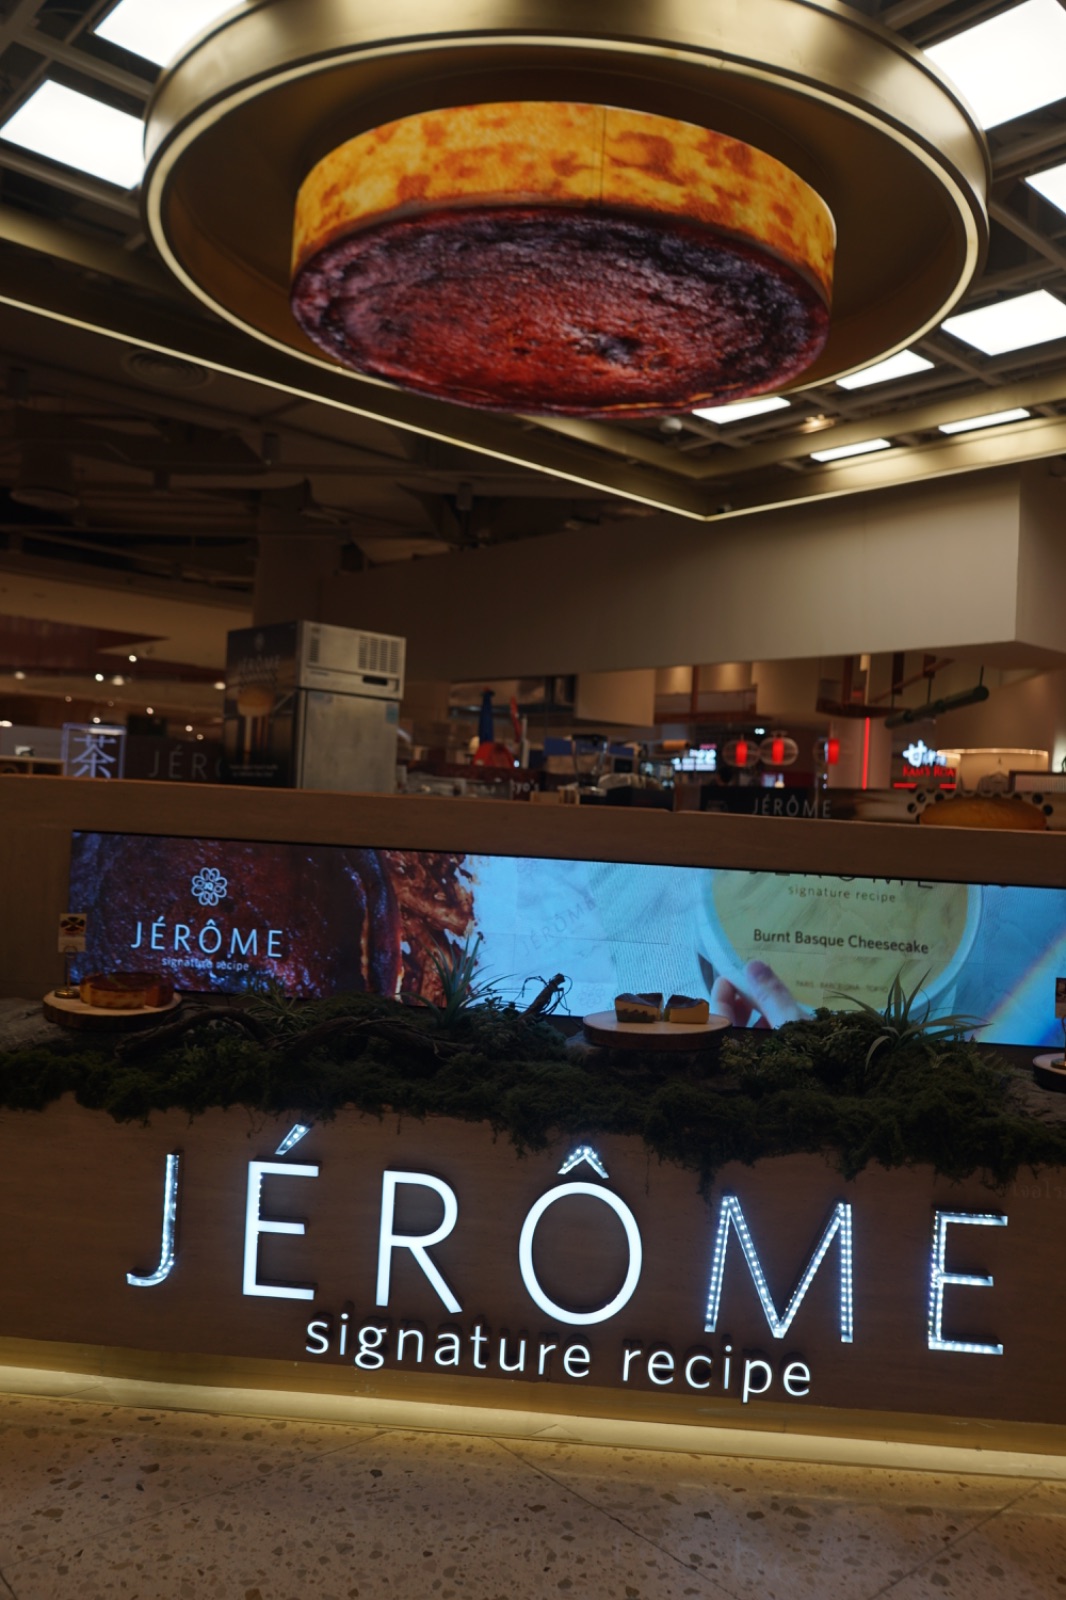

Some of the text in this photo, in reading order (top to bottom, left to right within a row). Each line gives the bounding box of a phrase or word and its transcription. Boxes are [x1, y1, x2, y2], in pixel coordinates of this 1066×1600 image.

[72, 734, 116, 779] 茶
[752, 793, 832, 818] JÉRÔME
[788, 884, 896, 903] signature recipe
[130, 915, 283, 957] JÉRÔME
[753, 929, 929, 954] Burnt Basque Cheesecake
[161, 956, 249, 971] signature recipe
[126, 1123, 1010, 1355] JÉRÔME
[305, 1312, 812, 1404] signature recipe
